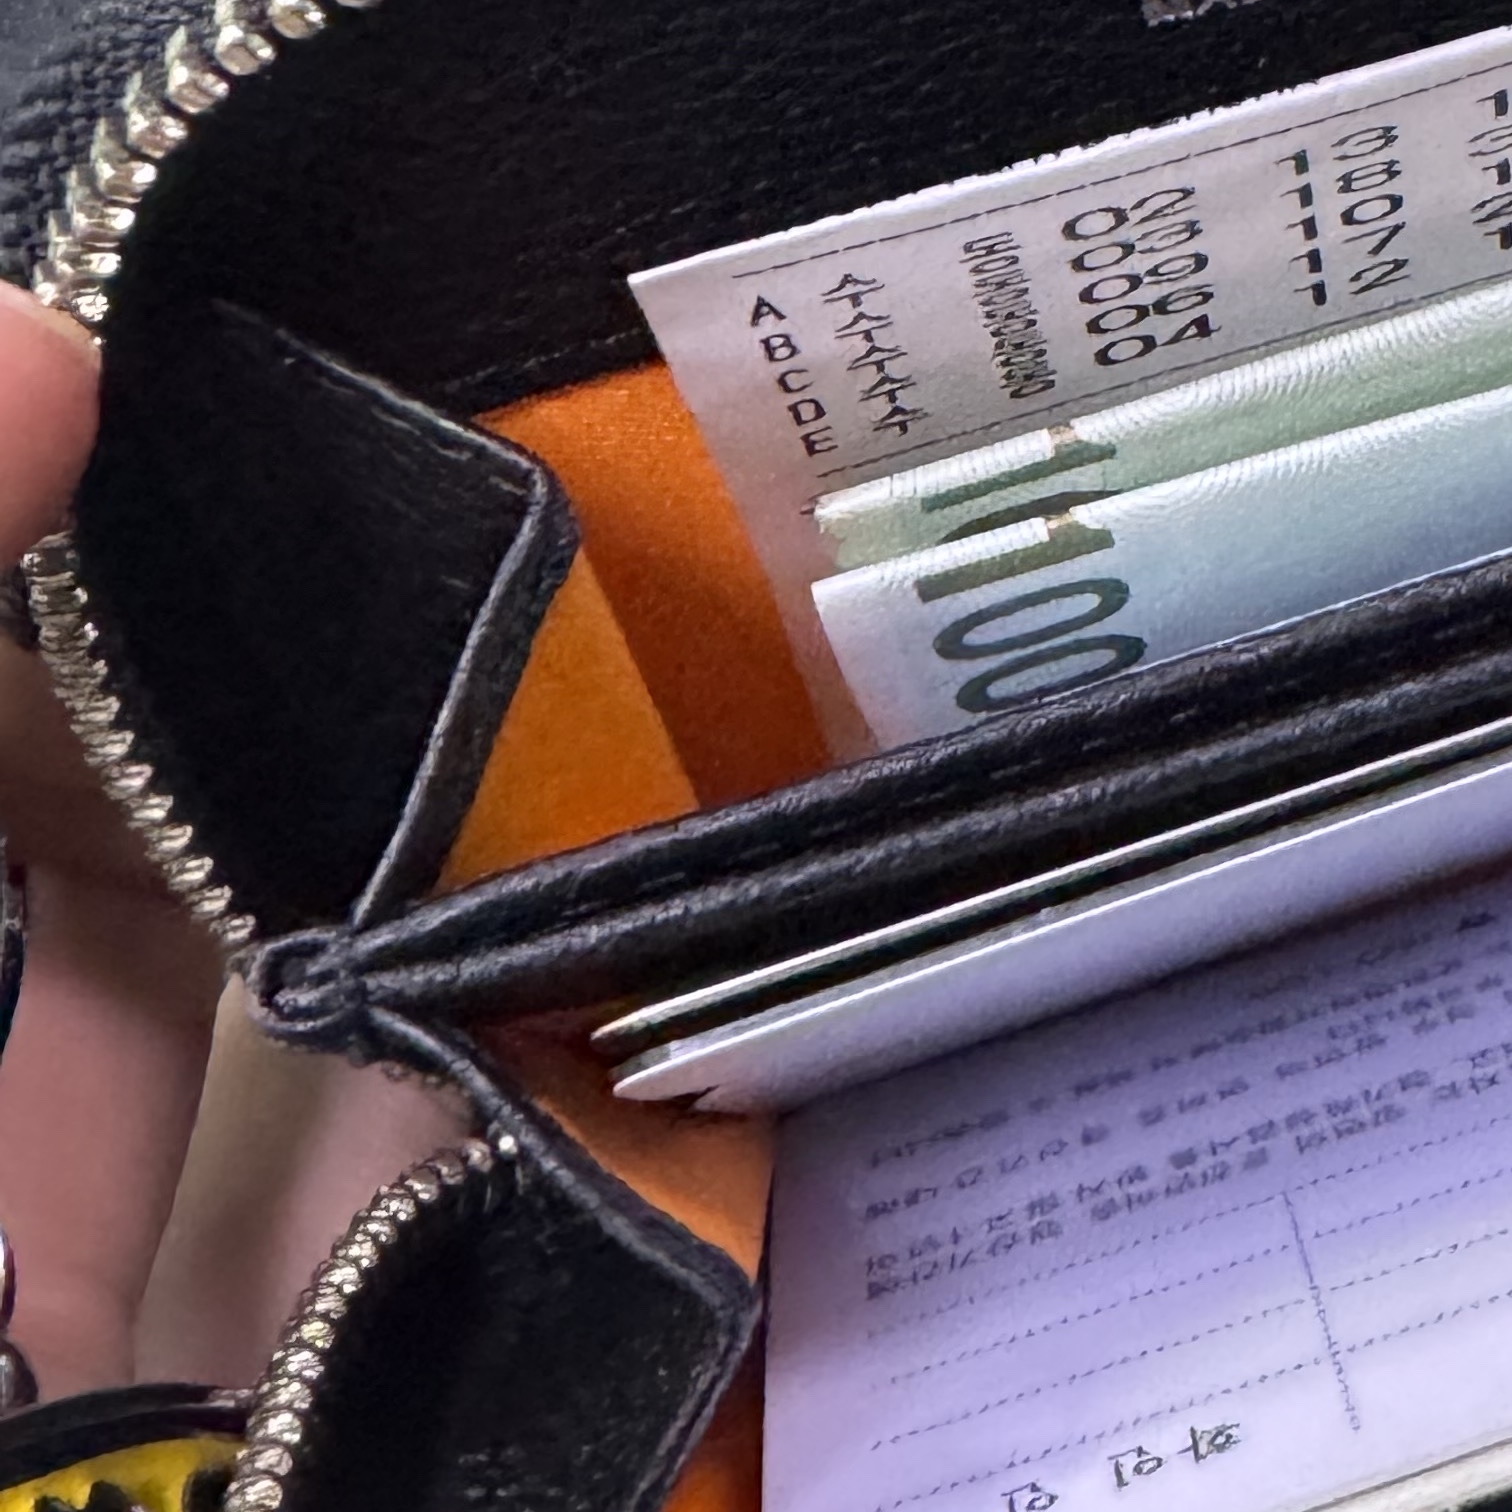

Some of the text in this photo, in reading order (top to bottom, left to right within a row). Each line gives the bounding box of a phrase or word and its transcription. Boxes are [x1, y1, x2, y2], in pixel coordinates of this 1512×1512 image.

[751, 295, 787, 327] A
[1062, 187, 1196, 241] 02
[1273, 126, 1399, 176] 13
[760, 334, 802, 362] B
[1069, 219, 1203, 273] 03
[1280, 159, 1402, 209] 18
[777, 368, 814, 394] C
[1078, 253, 1209, 304] 09
[1285, 193, 1403, 241] 10
[787, 398, 826, 426] D
[1086, 283, 1214, 334] 06
[1288, 221, 1406, 274] 17
[800, 426, 839, 458] E
[1094, 313, 1222, 366] 04
[1293, 257, 1412, 306] 12
